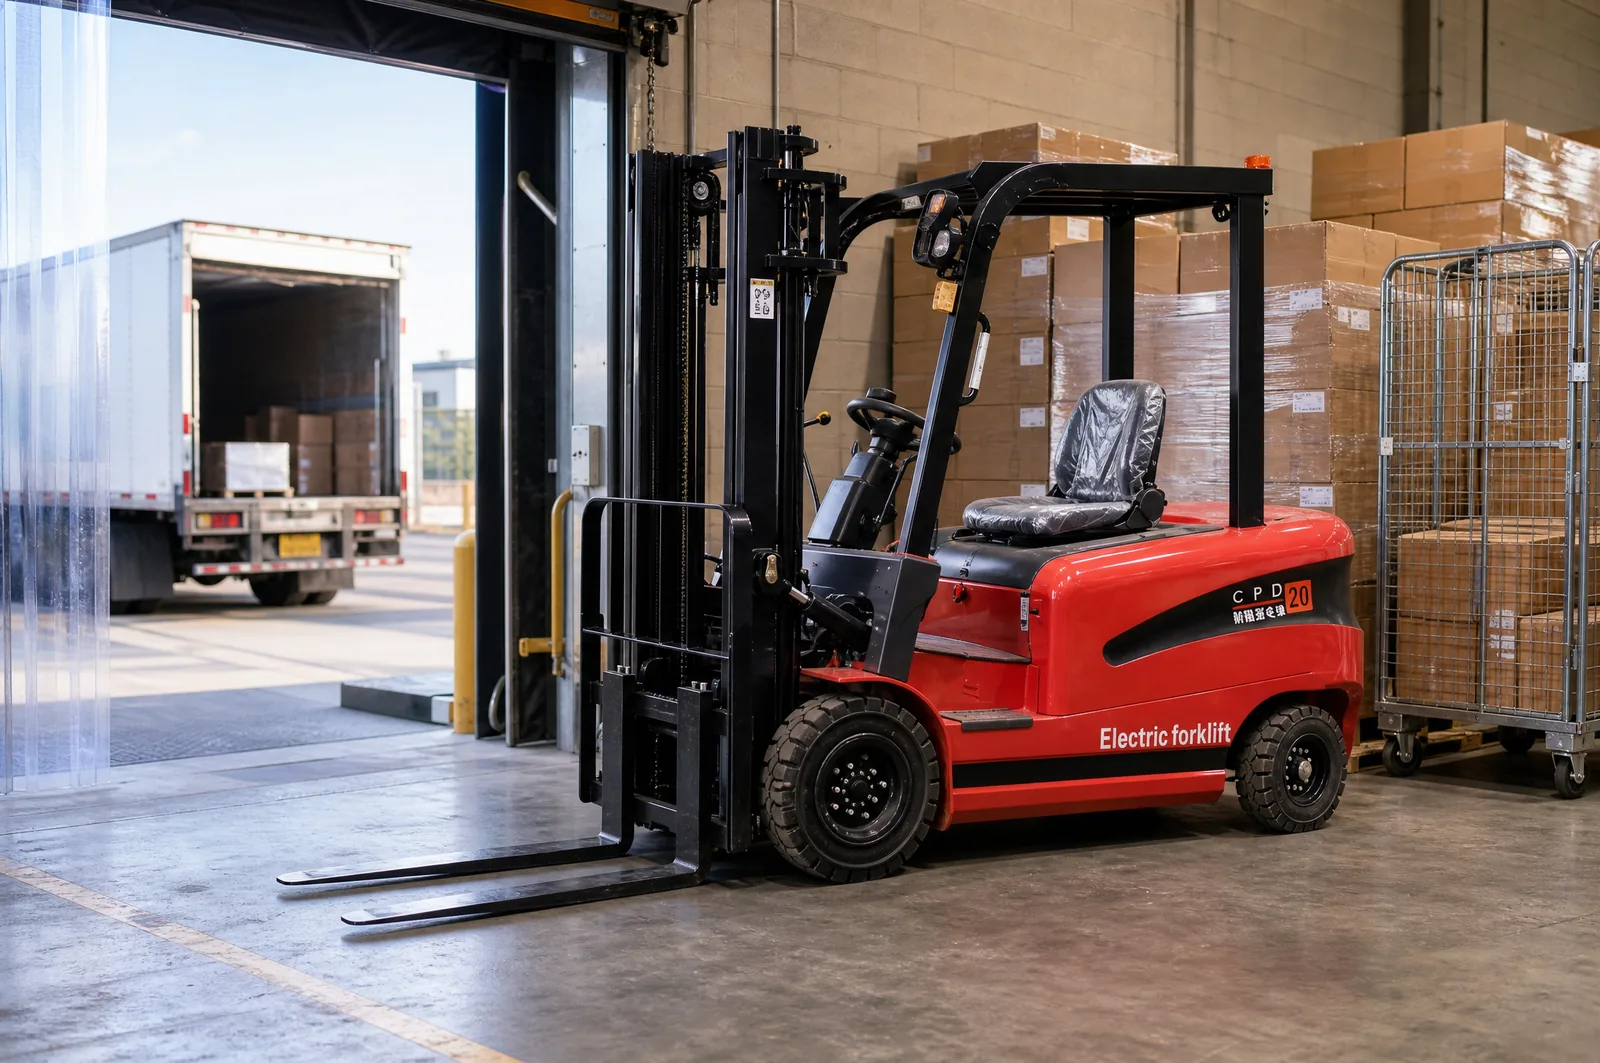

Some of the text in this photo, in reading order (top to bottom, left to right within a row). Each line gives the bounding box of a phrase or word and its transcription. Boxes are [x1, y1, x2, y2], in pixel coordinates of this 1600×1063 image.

[1288, 586, 1309, 608] 20
[1100, 722, 1231, 749] Electric forklift
